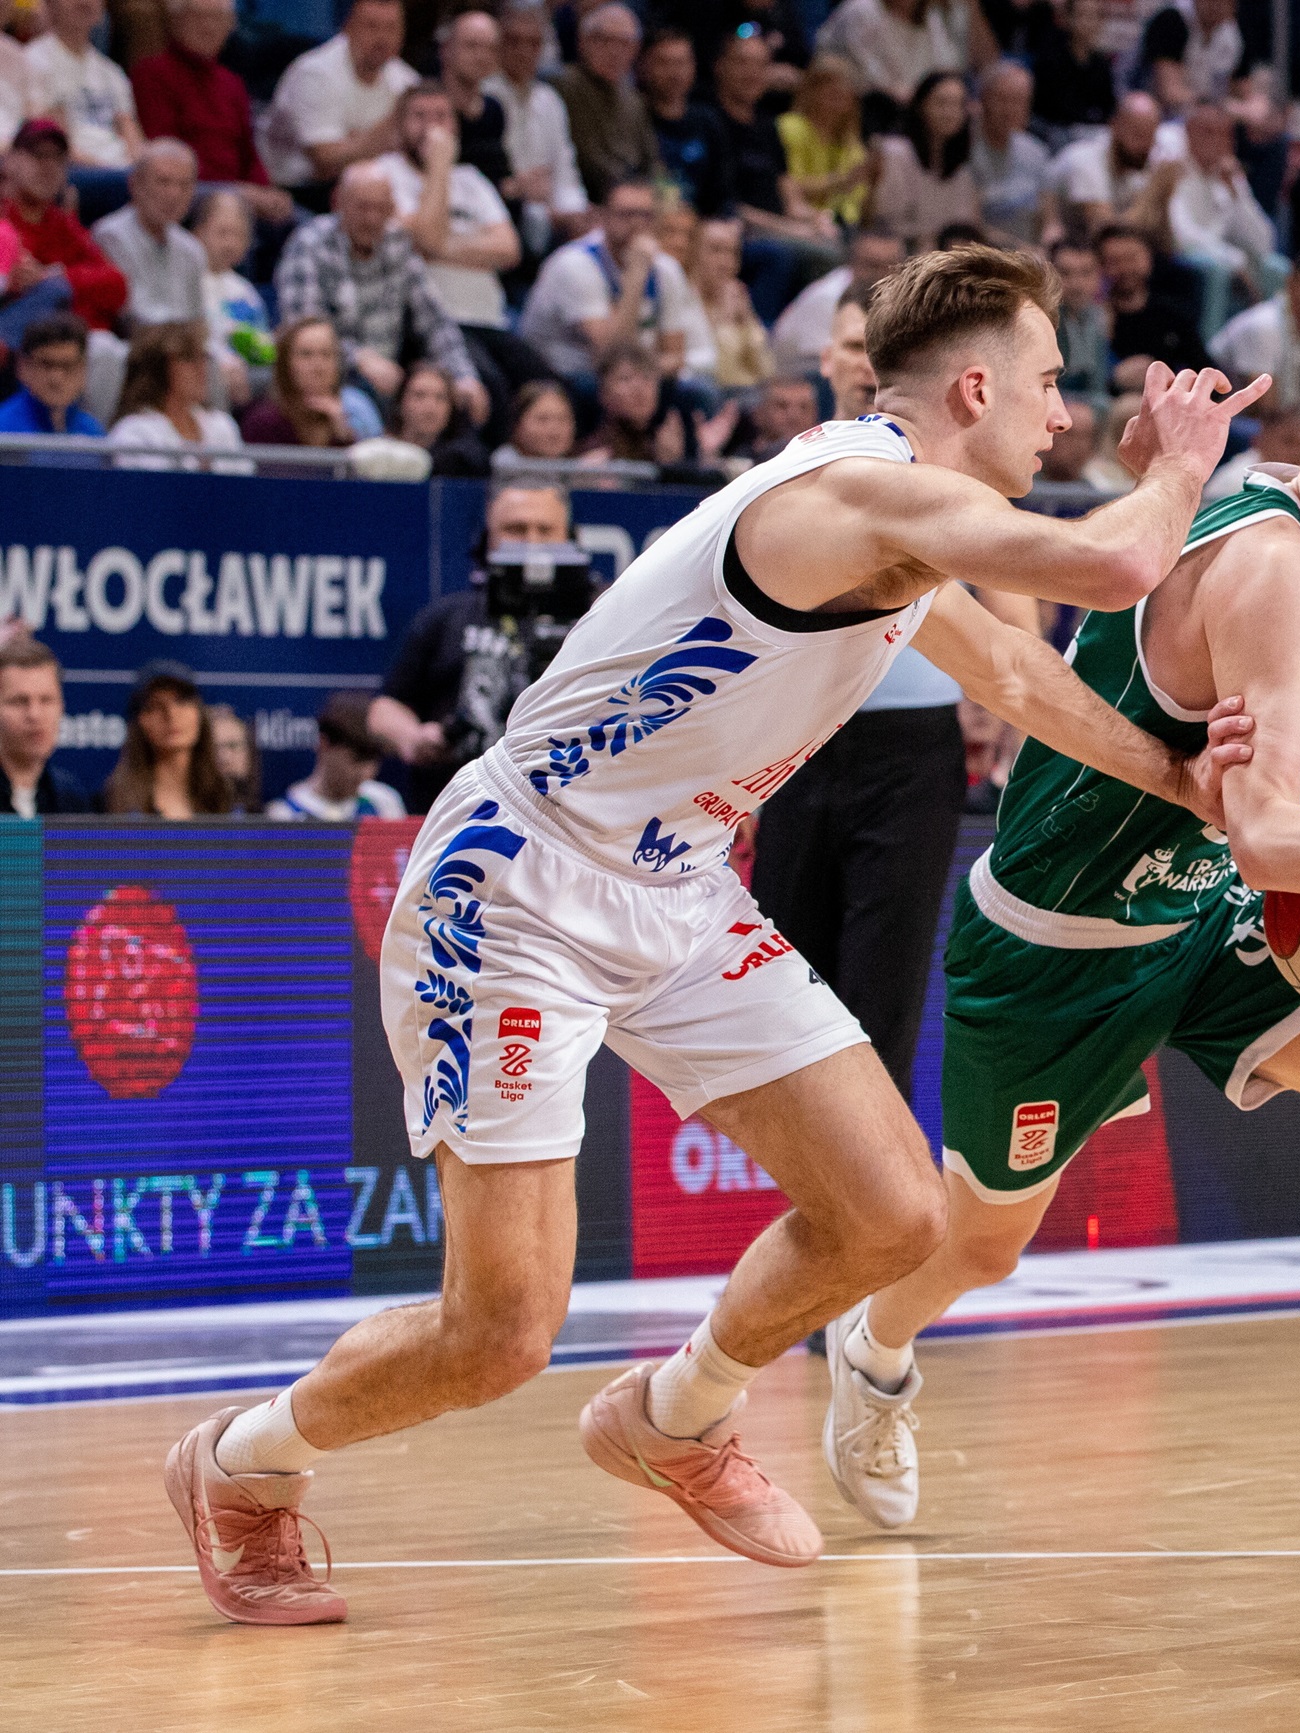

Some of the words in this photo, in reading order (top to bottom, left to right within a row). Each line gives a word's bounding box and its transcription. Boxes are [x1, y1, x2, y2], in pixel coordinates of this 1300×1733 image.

[0, 544, 388, 640] WŁOCŁAWEK
[693, 791, 739, 826] GRUPA
[722, 934, 794, 980] ORLE
[501, 1018, 540, 1029] ORLEN
[494, 1080, 533, 1091] Basket
[501, 1091, 525, 1102] Liga
[1018, 1110, 1055, 1121] ORLEN
[0, 1172, 227, 1268] UNKTY
[242, 1169, 330, 1257] ZA
